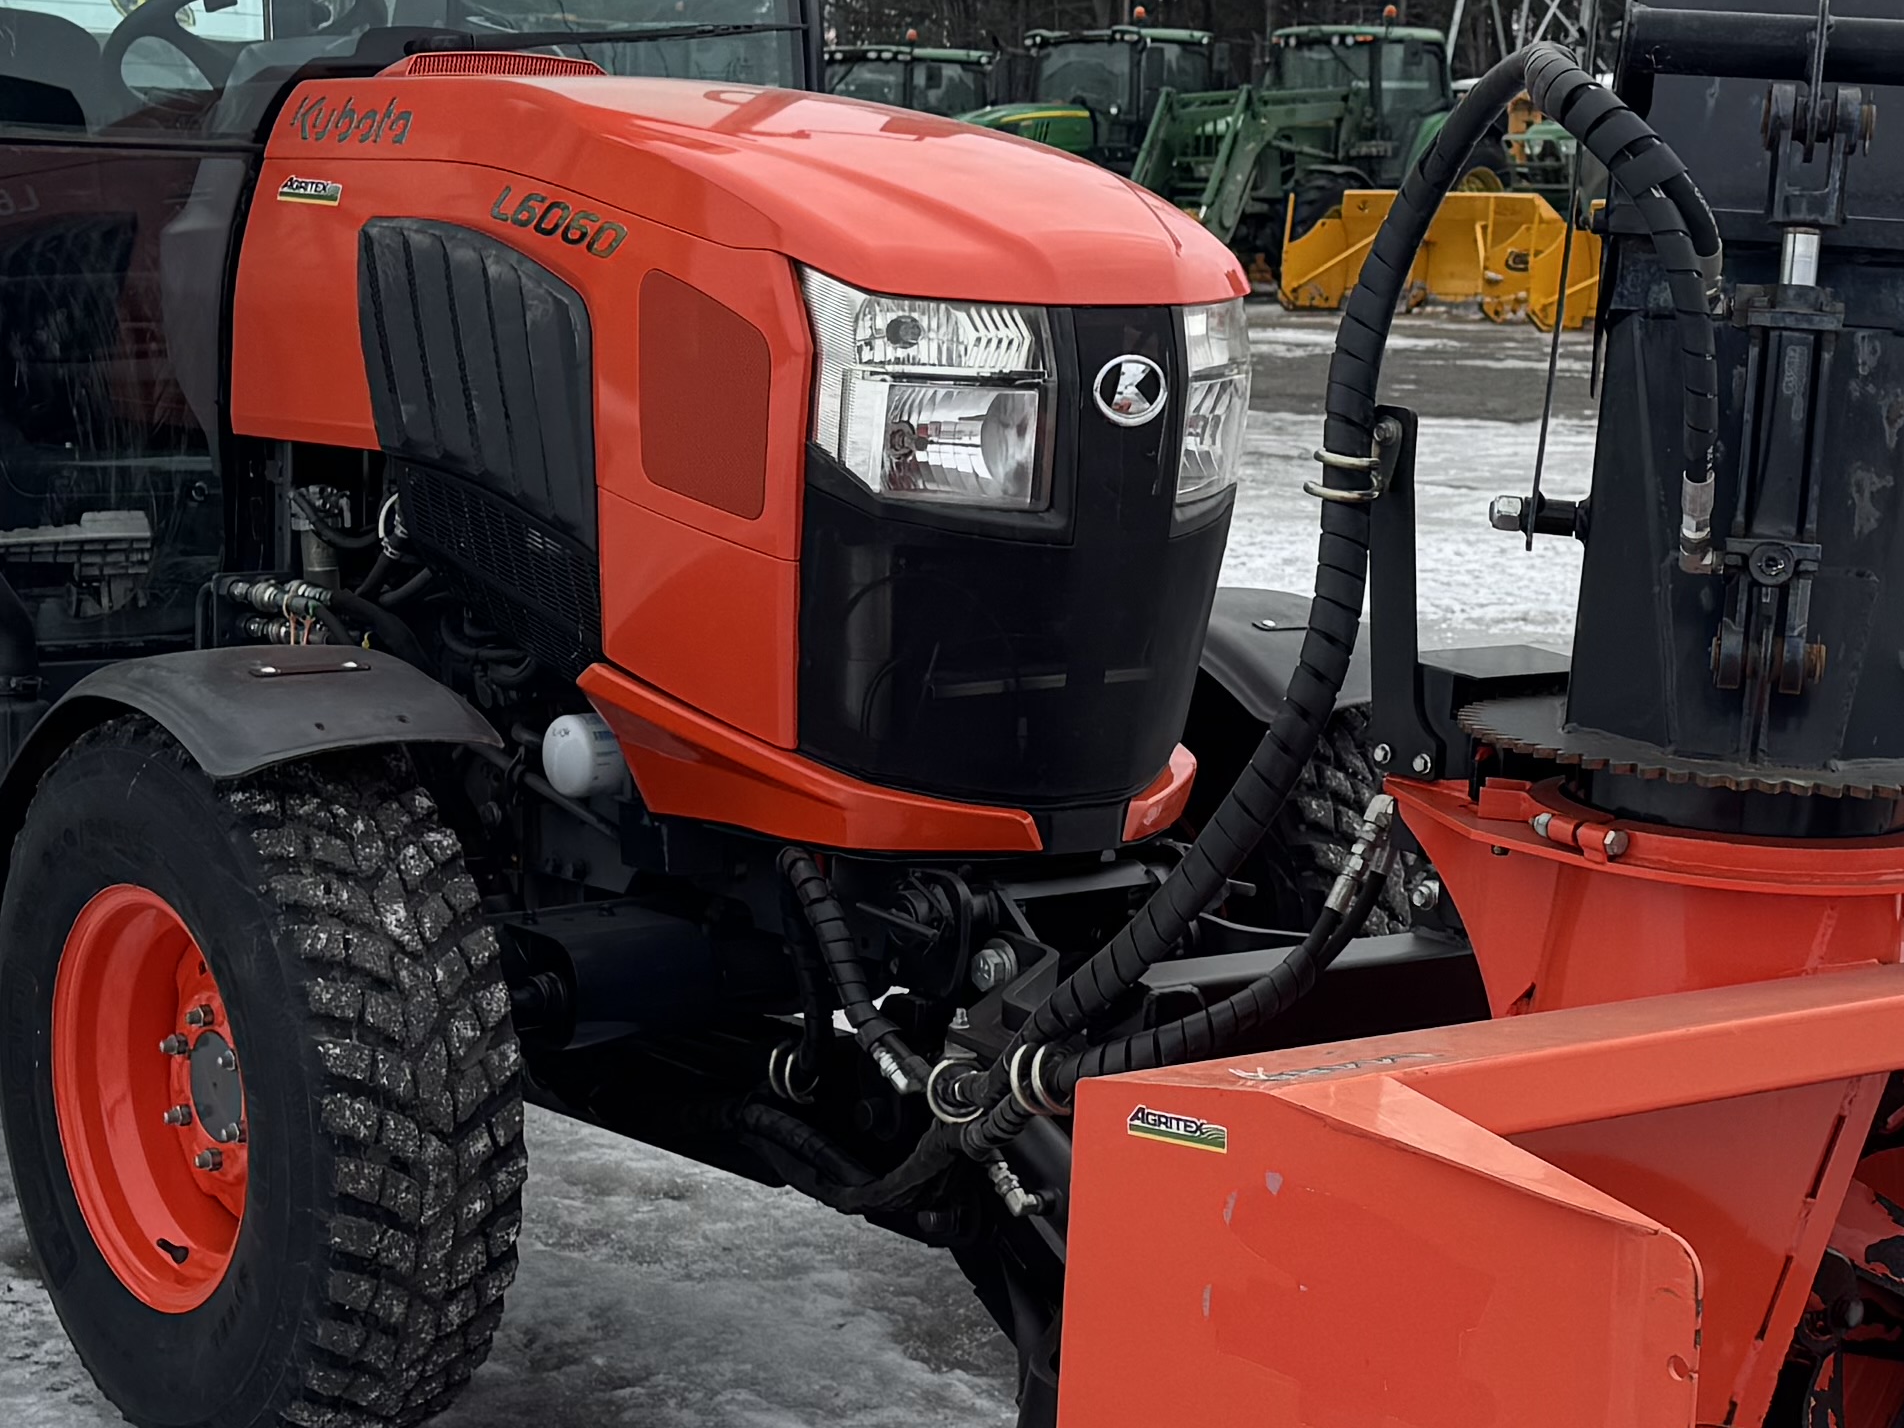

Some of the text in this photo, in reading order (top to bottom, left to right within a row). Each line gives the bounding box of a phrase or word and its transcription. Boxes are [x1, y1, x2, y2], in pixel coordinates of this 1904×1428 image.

[290, 95, 413, 144] Kubota
[490, 185, 629, 259] L6060
[1130, 1106, 1207, 1135] AGRITEX
